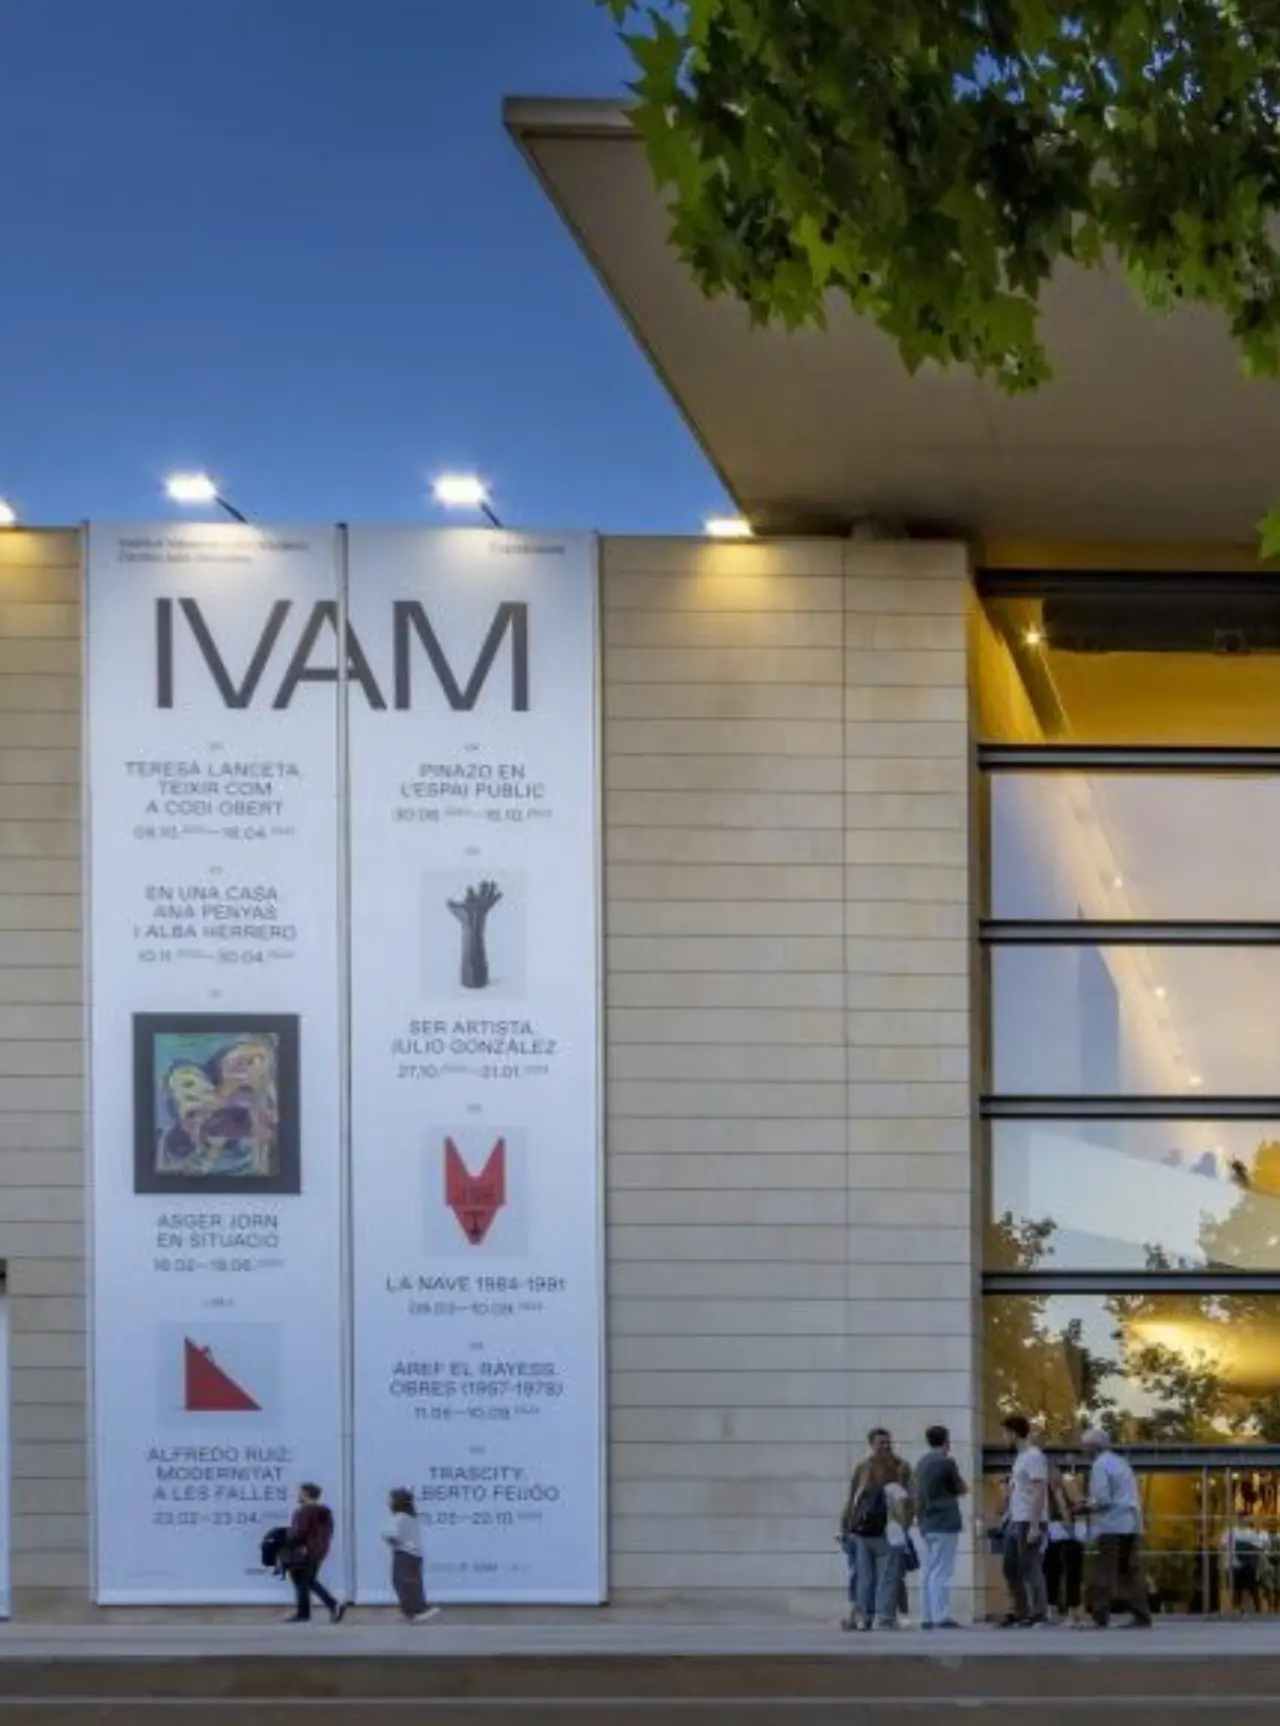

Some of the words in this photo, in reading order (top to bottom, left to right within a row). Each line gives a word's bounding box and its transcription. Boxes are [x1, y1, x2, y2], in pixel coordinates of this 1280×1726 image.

[155, 597, 530, 711] IVAM
[125, 761, 201, 778] TERESA
[498, 763, 527, 779] EN
[145, 885, 174, 901] EN
[178, 885, 220, 901] UNA
[408, 1019, 447, 1036] SER
[156, 1231, 183, 1248] EN
[386, 1275, 413, 1293] LA
[418, 1275, 471, 1293] NAVE
